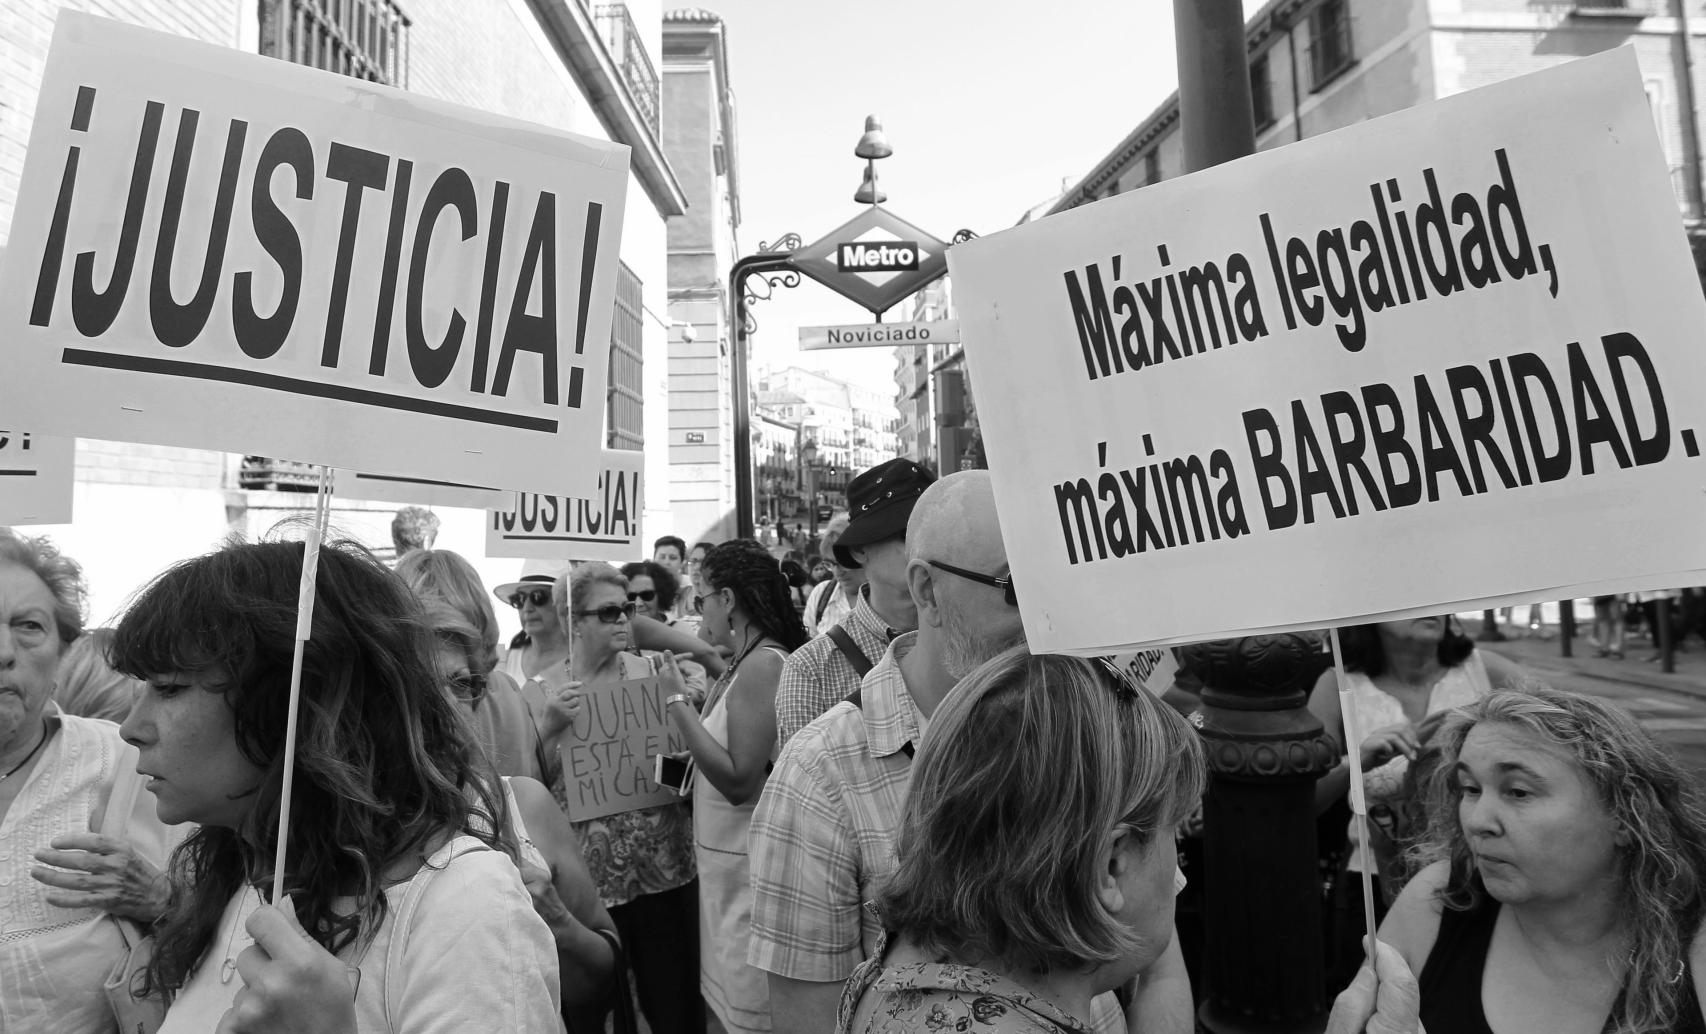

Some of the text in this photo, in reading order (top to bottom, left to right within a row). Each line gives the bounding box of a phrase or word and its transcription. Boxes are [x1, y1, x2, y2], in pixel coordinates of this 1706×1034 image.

[29, 86, 602, 408] ¡JUSTICIA!
[827, 326, 930, 343] Noviciado
[843, 245, 914, 267] Metro
[1064, 149, 1558, 380] Máxima legalidad,
[1054, 333, 1699, 564] máxima BARBARIDAD.
